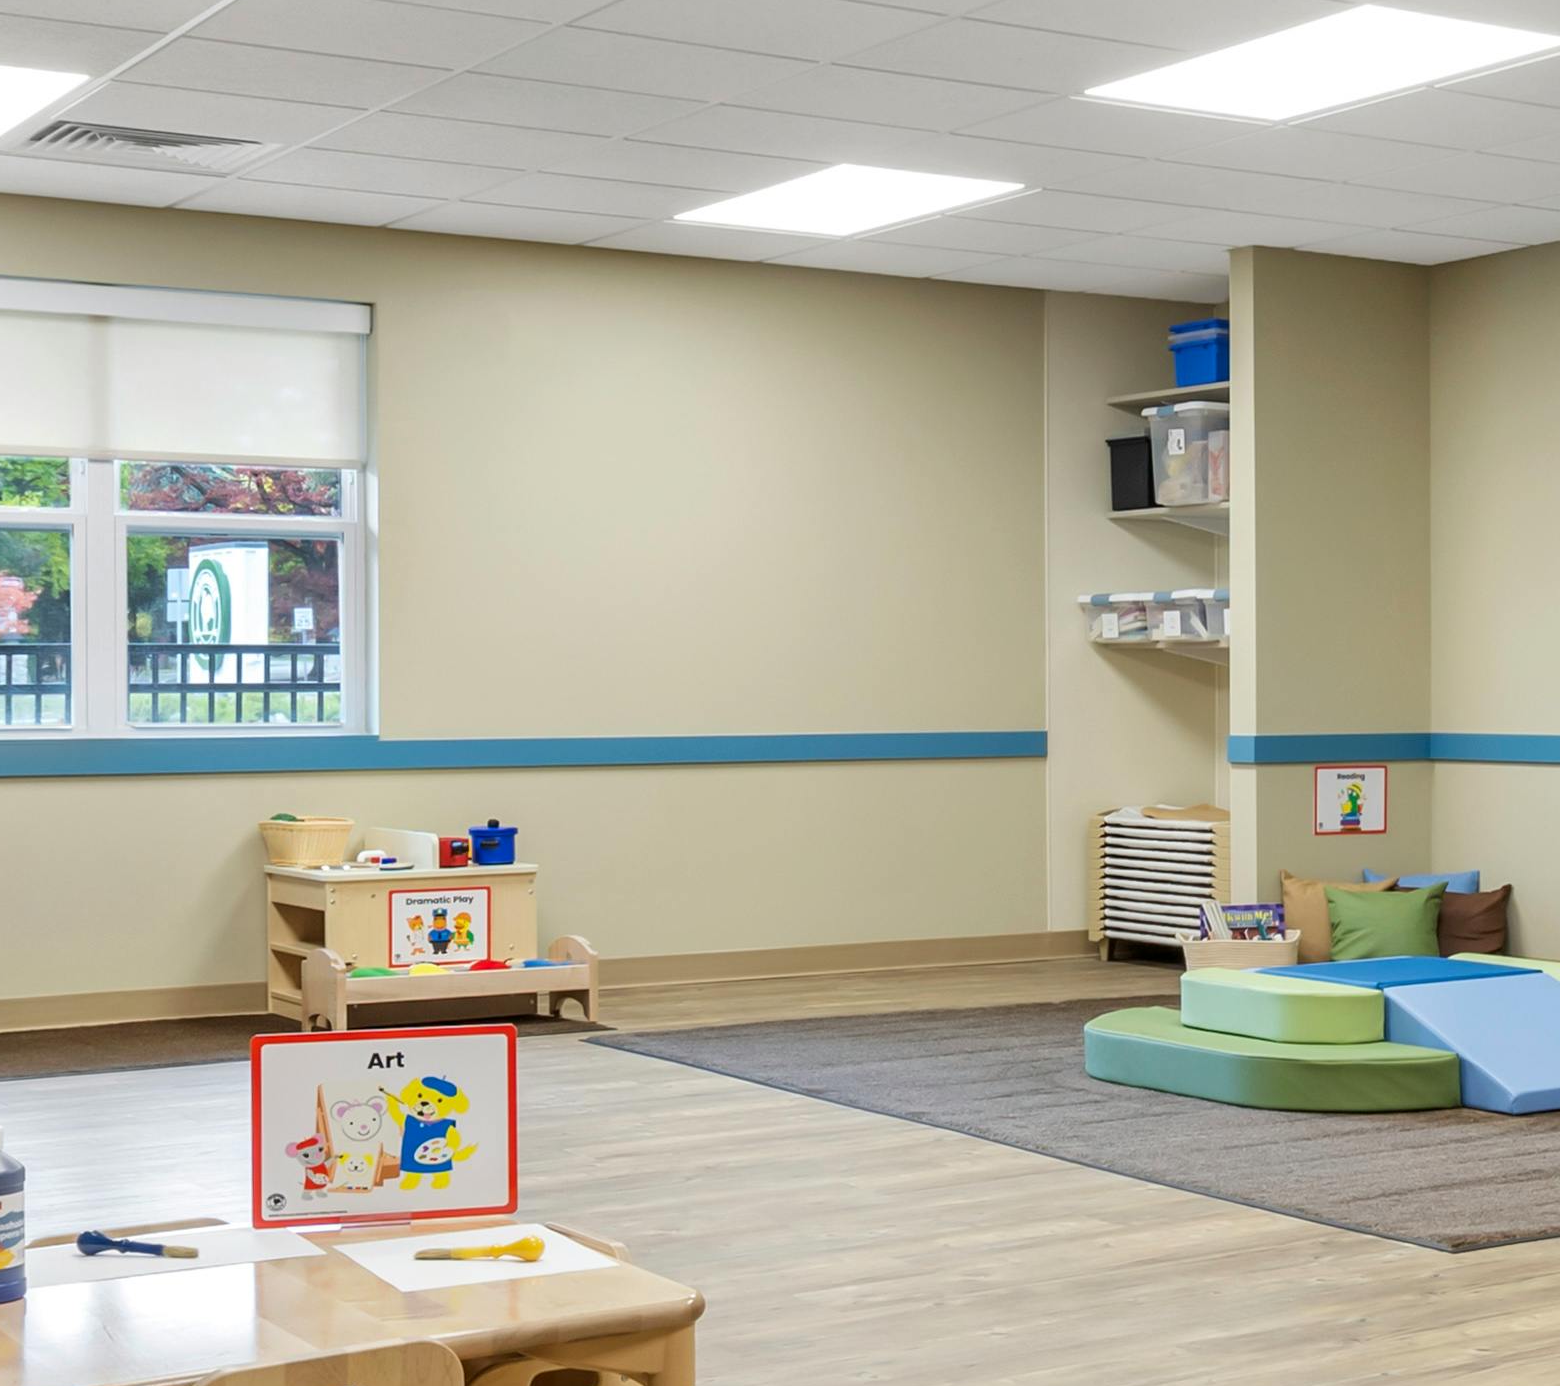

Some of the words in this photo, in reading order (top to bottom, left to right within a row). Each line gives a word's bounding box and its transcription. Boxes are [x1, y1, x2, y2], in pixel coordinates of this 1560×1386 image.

[1337, 773, 1365, 781] Reading
[406, 896, 451, 906] Dramatic
[453, 895, 474, 904] Play
[367, 1052, 405, 1069] Art
